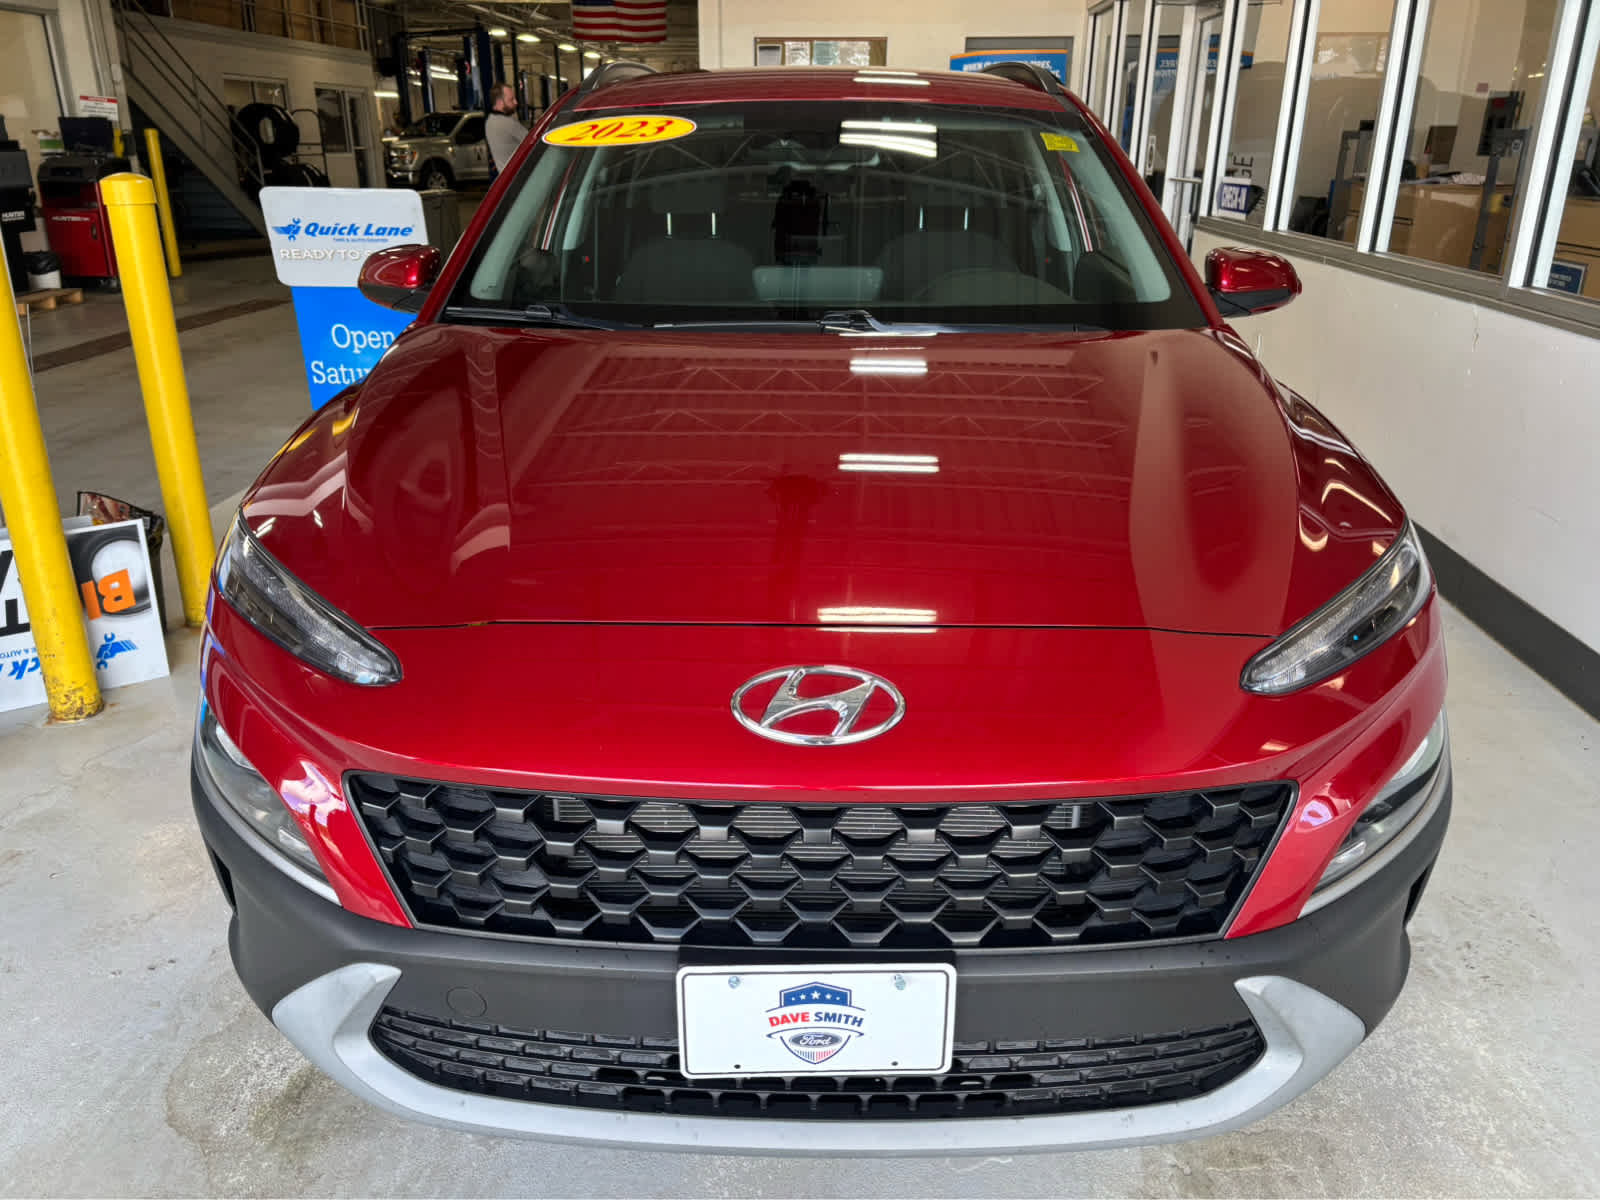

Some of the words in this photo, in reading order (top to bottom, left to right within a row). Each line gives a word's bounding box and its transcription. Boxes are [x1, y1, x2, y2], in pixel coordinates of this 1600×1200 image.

[565, 120, 674, 141] 2023
[304, 222, 359, 236] Quick
[363, 223, 413, 236] Lane
[279, 248, 334, 261] READY
[336, 249, 360, 261] TO
[331, 323, 395, 354] Open
[768, 1011, 810, 1027] DAVE
[814, 1011, 864, 1027] SMITH
[799, 1032, 833, 1046] Ford
